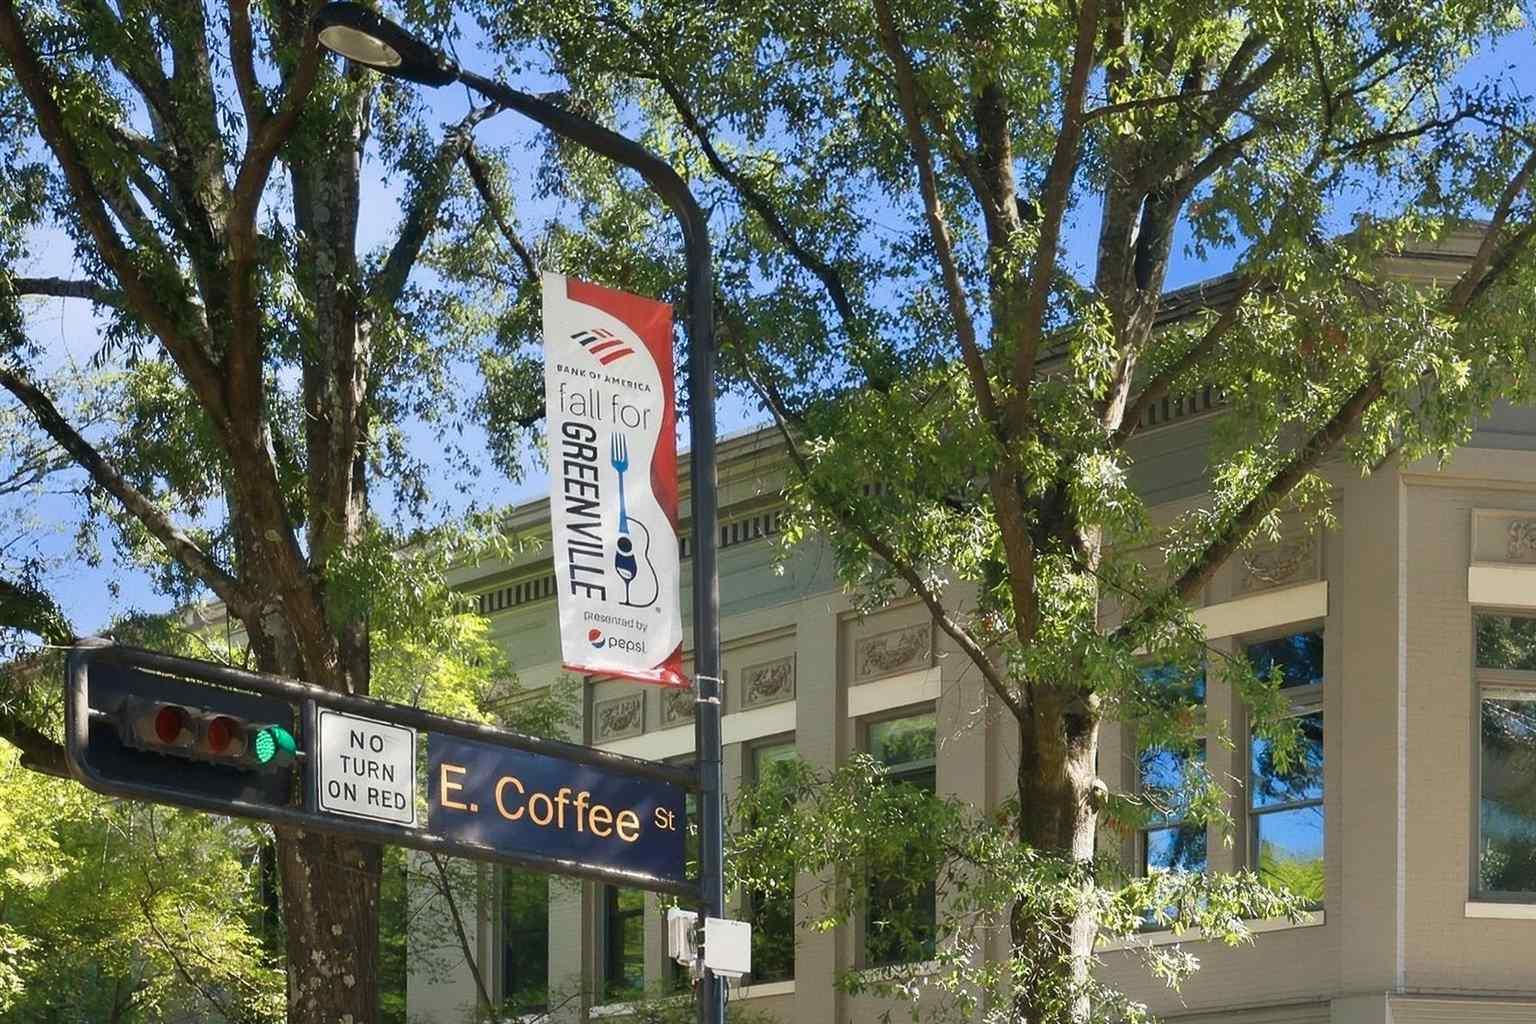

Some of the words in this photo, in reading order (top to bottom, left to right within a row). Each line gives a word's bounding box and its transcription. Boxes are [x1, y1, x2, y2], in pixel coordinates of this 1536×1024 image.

[556, 364, 587, 377] BANK
[604, 376, 651, 393] AMERICA
[559, 382, 602, 421] fall
[612, 394, 651, 431] for
[562, 421, 607, 602] GREENVILLE
[583, 611, 634, 629] presented
[635, 620, 649, 633] by
[608, 636, 647, 654] pepsi
[350, 729, 384, 753] NO
[340, 755, 394, 782] TURN
[328, 780, 356, 802] ON
[367, 787, 406, 810] RED
[440, 763, 479, 813] E.
[495, 776, 640, 843] Coffee
[654, 807, 676, 831] St
